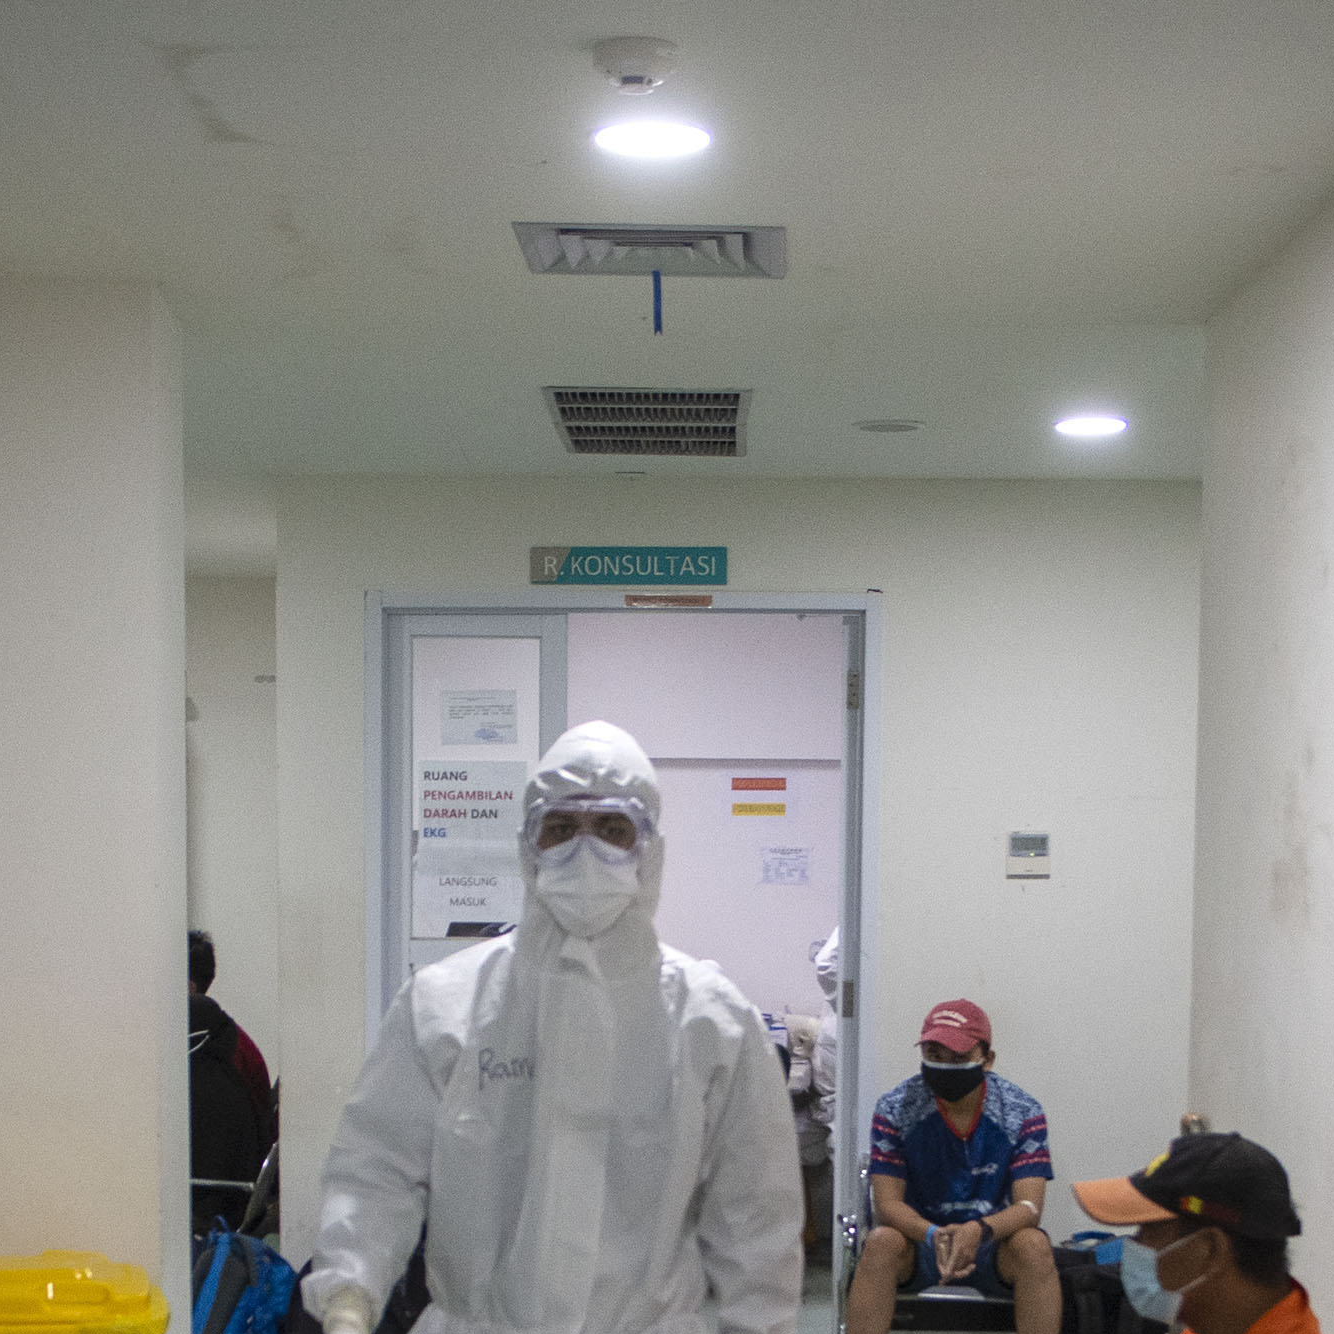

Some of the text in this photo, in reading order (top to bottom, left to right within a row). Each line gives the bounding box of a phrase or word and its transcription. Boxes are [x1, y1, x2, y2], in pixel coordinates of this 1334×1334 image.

[544, 555, 717, 577] R. KONSULTASI
[423, 770, 468, 781] RUANG
[423, 790, 514, 801] PENGAMBILAN
[423, 808, 498, 819] DARAH DAN
[423, 827, 447, 838] EKG
[438, 876, 498, 887] LANGSUNG
[449, 896, 487, 907] MASUK
